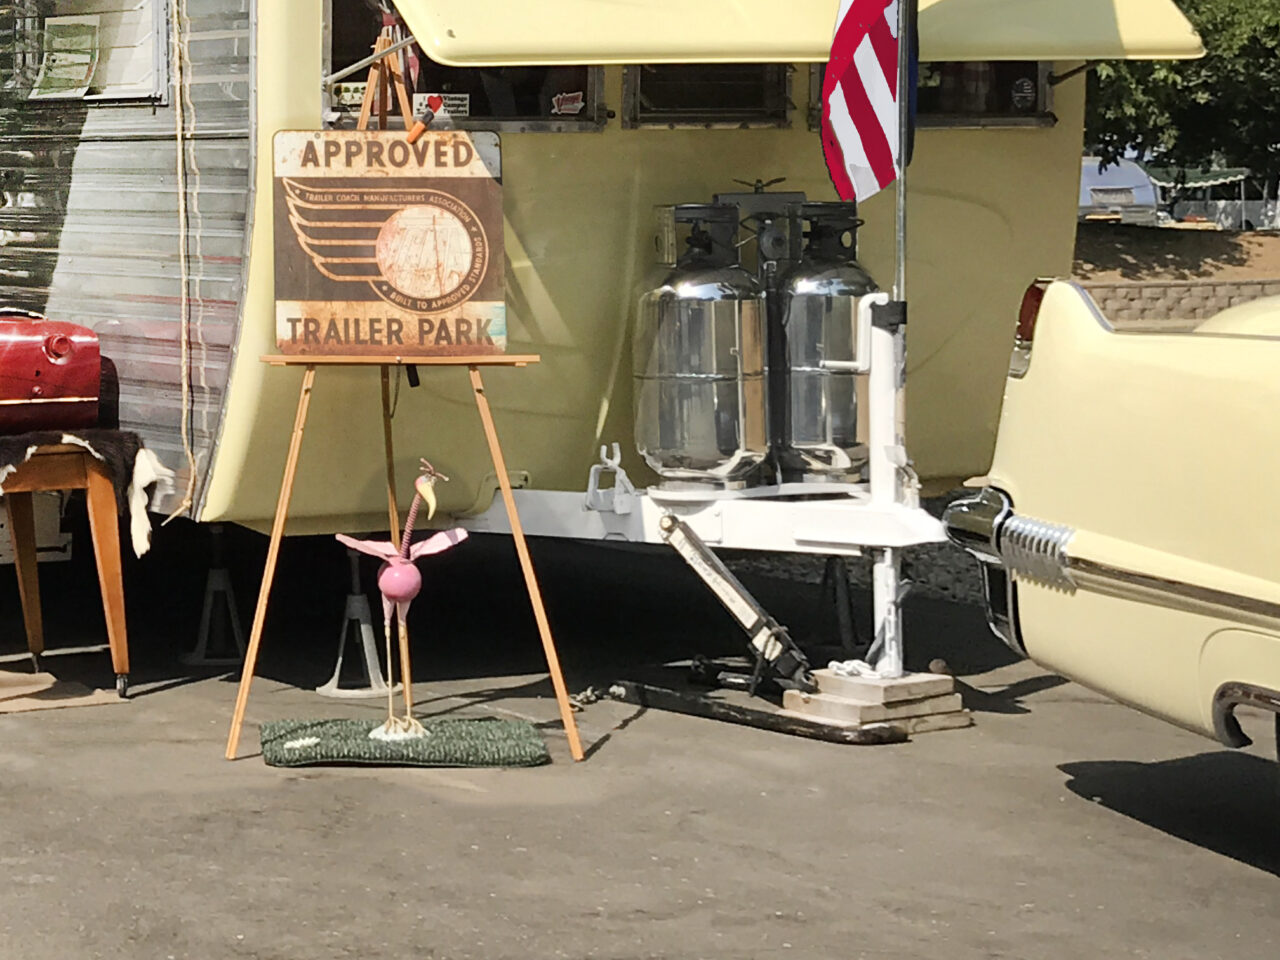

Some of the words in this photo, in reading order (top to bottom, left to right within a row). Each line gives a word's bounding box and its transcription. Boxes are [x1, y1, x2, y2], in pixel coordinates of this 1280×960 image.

[301, 140, 473, 168] APPROVED
[305, 193, 333, 202] TRAILER
[364, 194, 425, 202] MANUFACTURERS
[429, 195, 471, 223] ASSOCIATION
[390, 292, 412, 306] BUILT
[417, 301, 428, 309] TO
[431, 284, 470, 309] APPROVED
[468, 237, 483, 283] STANDARDS
[287, 318, 404, 346] TRAILER
[418, 318, 494, 346] PARK
